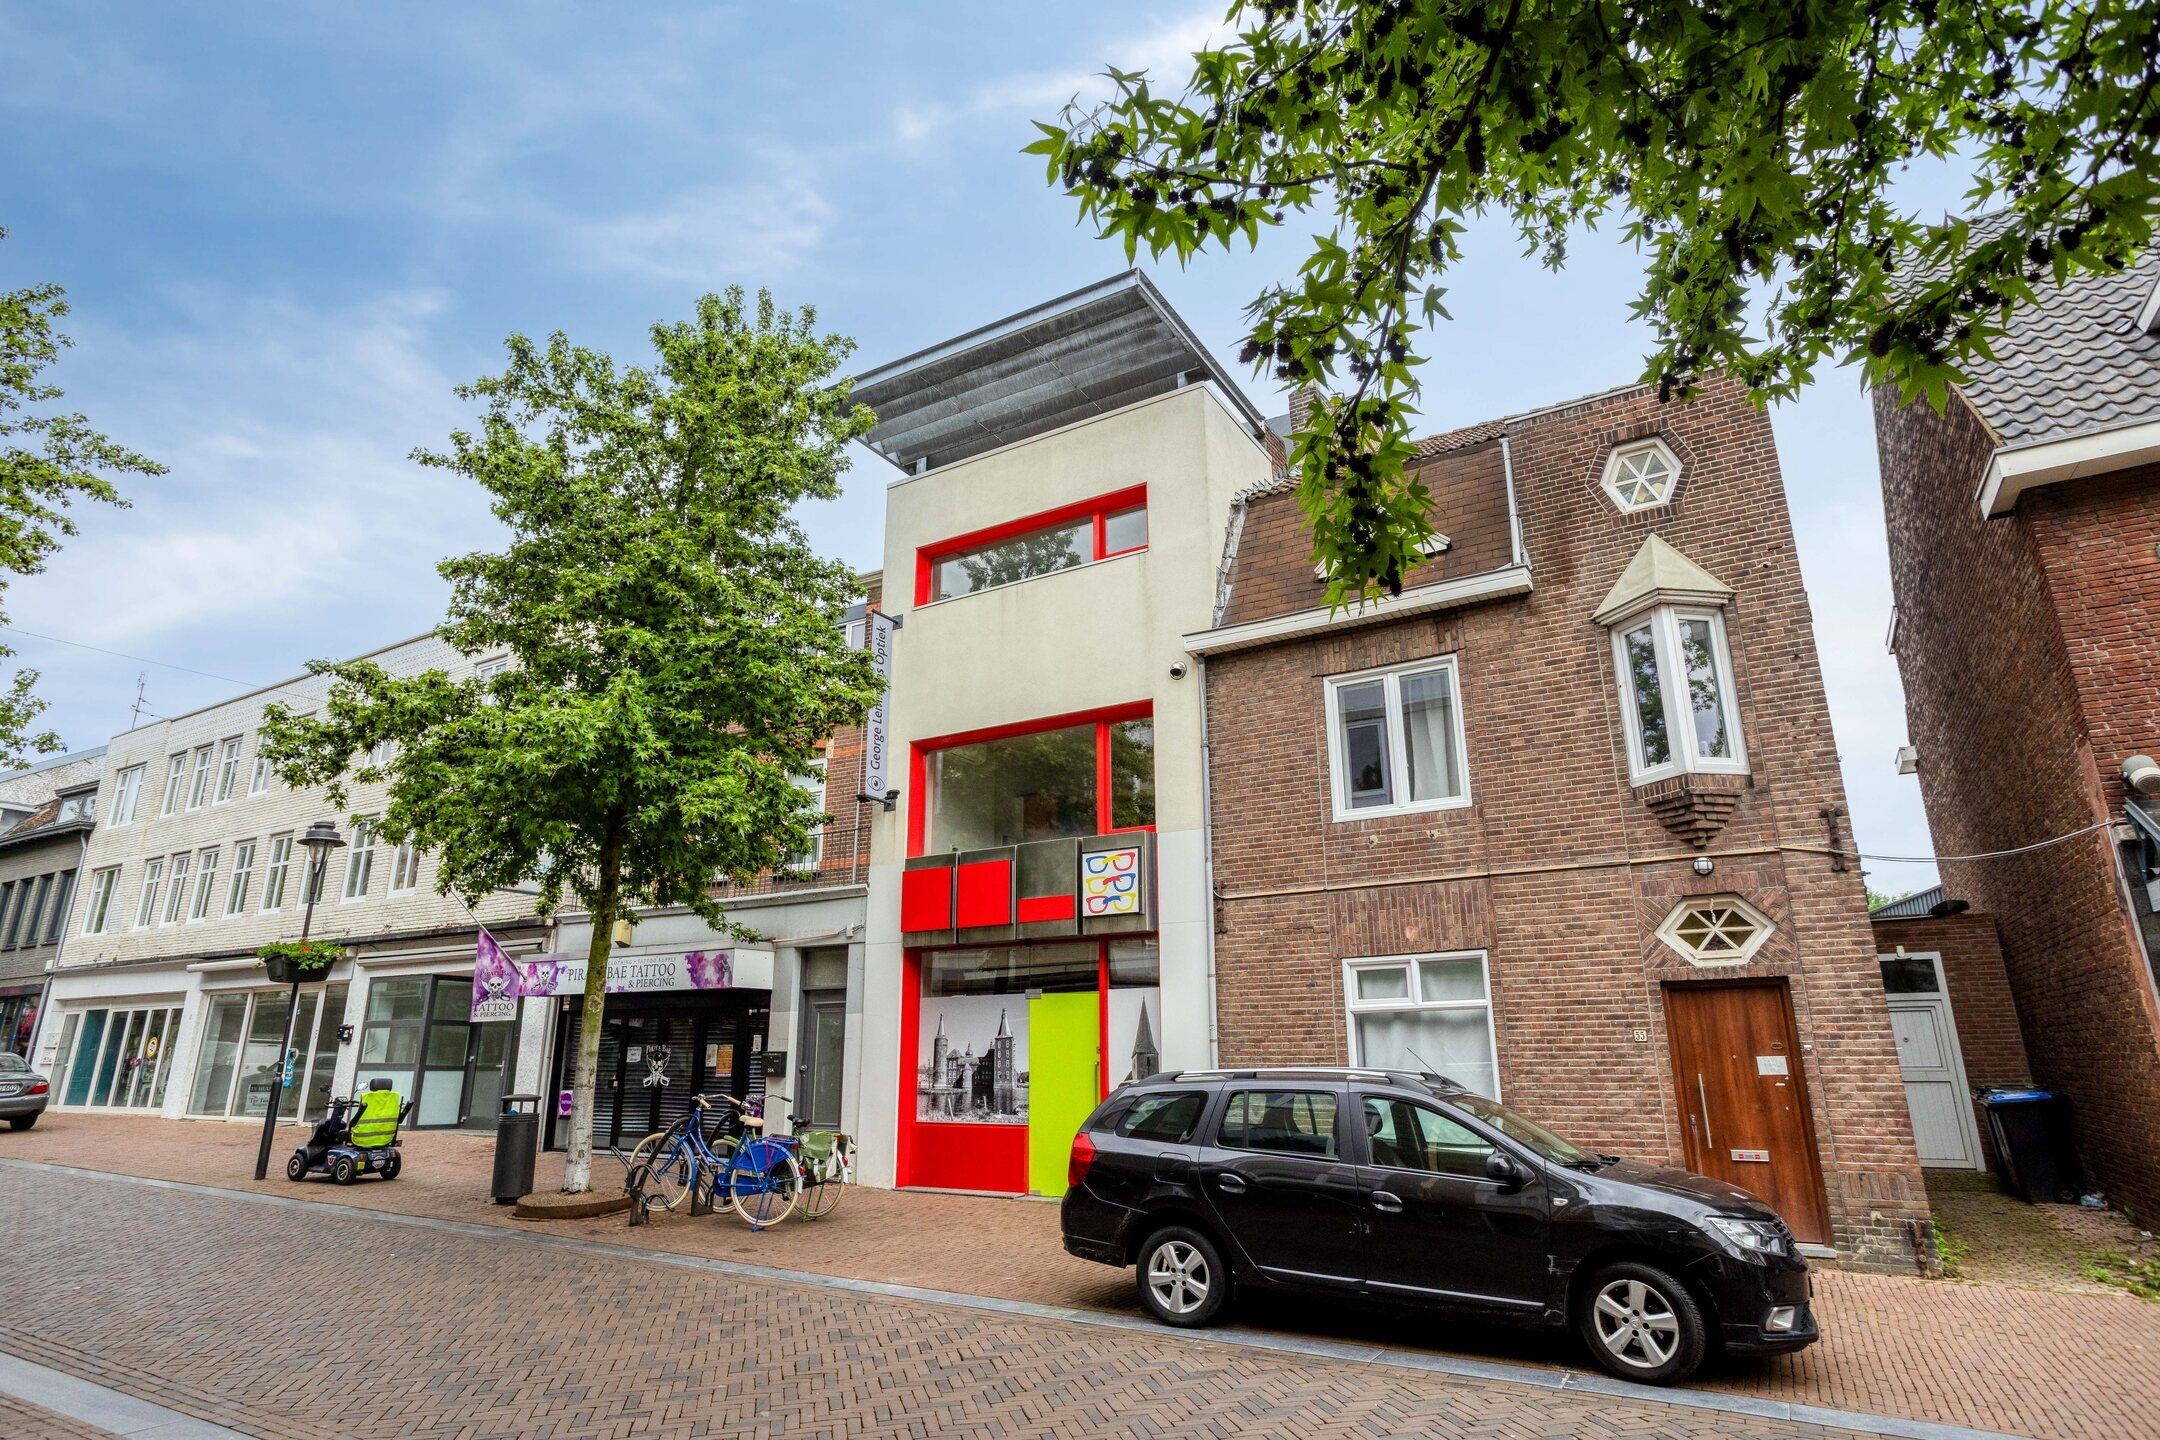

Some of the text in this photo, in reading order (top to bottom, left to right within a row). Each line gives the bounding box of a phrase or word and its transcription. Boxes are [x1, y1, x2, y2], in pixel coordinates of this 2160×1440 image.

[875, 625, 887, 665] Optiek
[870, 727, 885, 770] George
[607, 965, 628, 979] BAE
[630, 962, 676, 978] TATTOO
[628, 977, 675, 988] & PIERCING
[473, 1002, 514, 1012] TATTOO
[1635, 1031, 1646, 1041] 55
